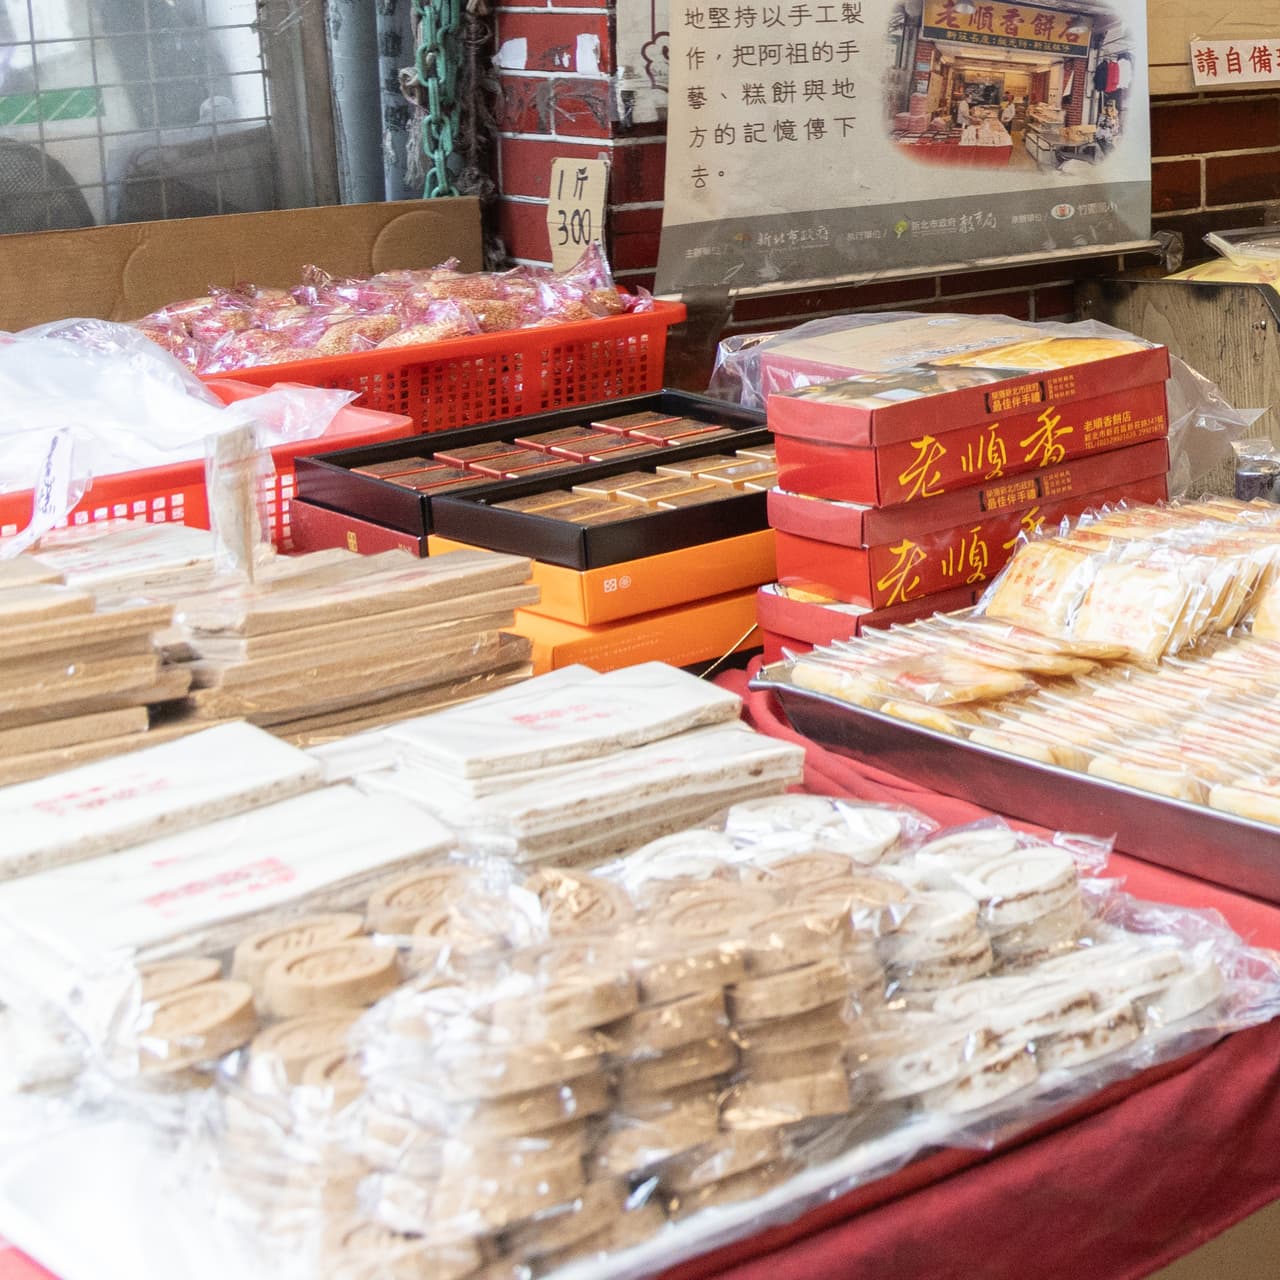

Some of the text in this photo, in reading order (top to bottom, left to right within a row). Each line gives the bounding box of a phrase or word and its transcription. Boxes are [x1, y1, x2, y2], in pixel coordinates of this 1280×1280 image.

[683, 0, 864, 31] 地堅持以手工製
[685, 39, 861, 72] 作，把阿祖的手
[686, 77, 857, 111] 藝、糕餅與地
[687, 114, 857, 150] 方的記憶傳下
[690, 163, 727, 191] 去。
[558, 209, 591, 245] 300
[898, 405, 1074, 502] 老順香
